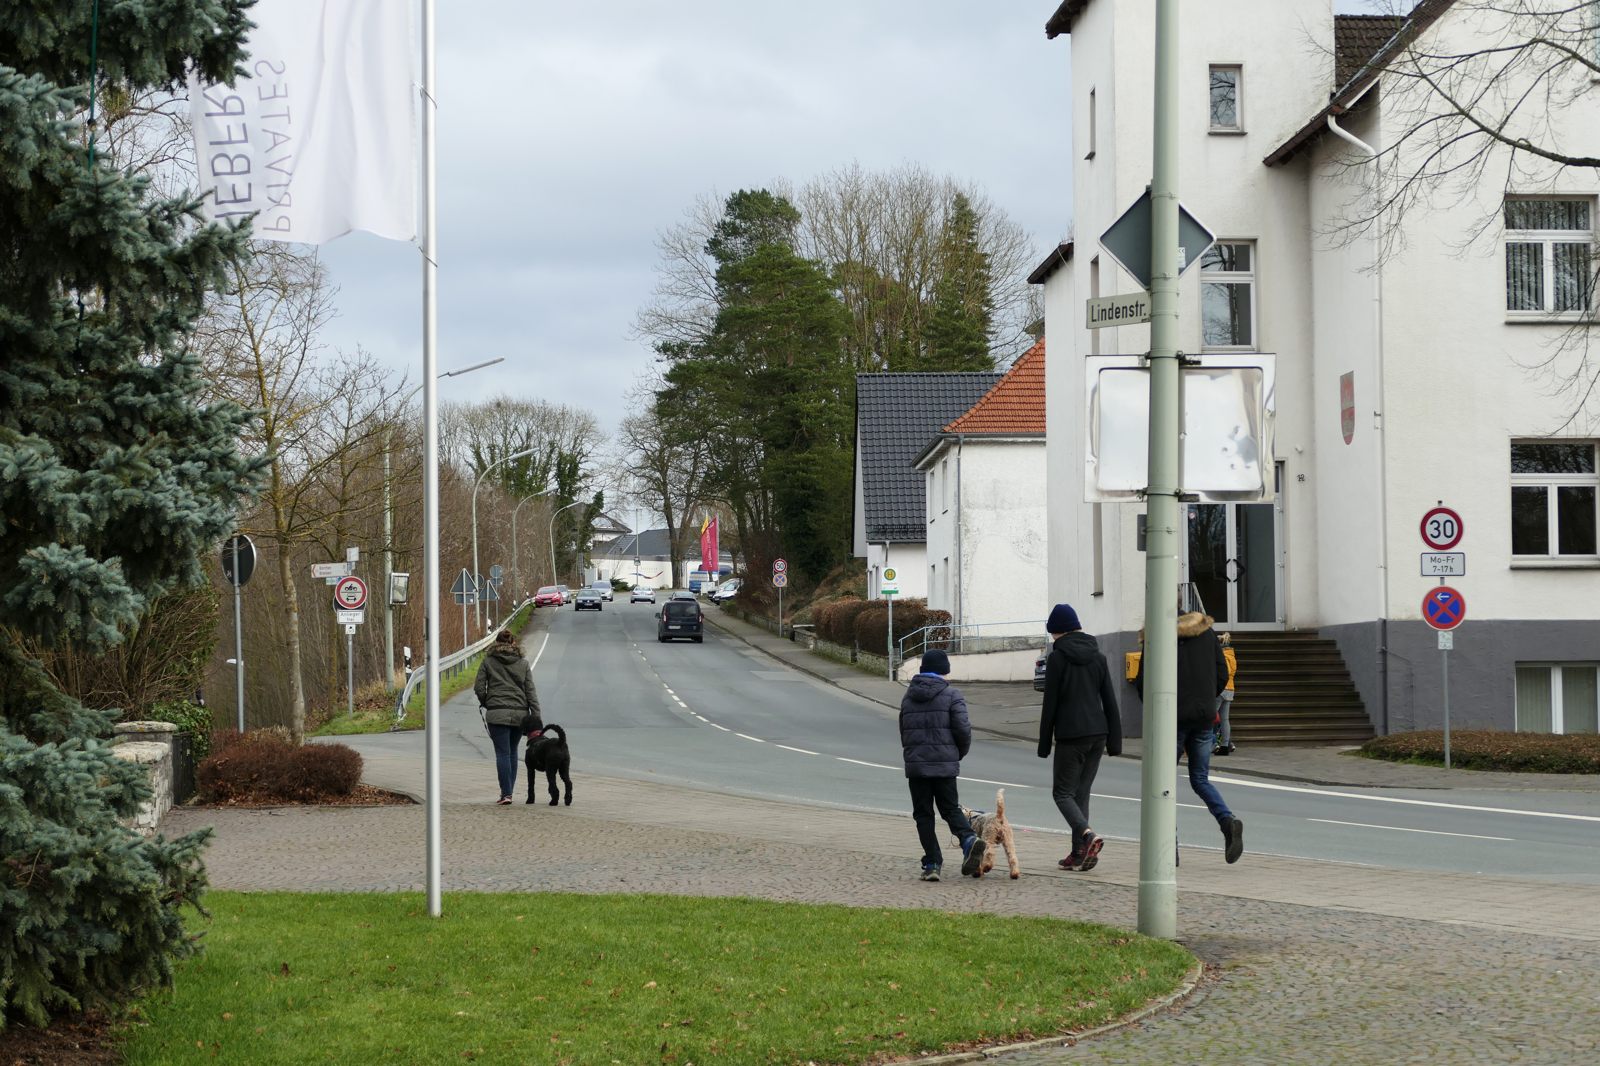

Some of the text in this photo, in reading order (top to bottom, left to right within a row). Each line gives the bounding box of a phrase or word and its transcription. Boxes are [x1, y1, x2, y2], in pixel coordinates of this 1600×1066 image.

[1091, 300, 1147, 323] Lindenstr.
[1429, 519, 1455, 539] 30
[776, 562, 785, 570] 50
